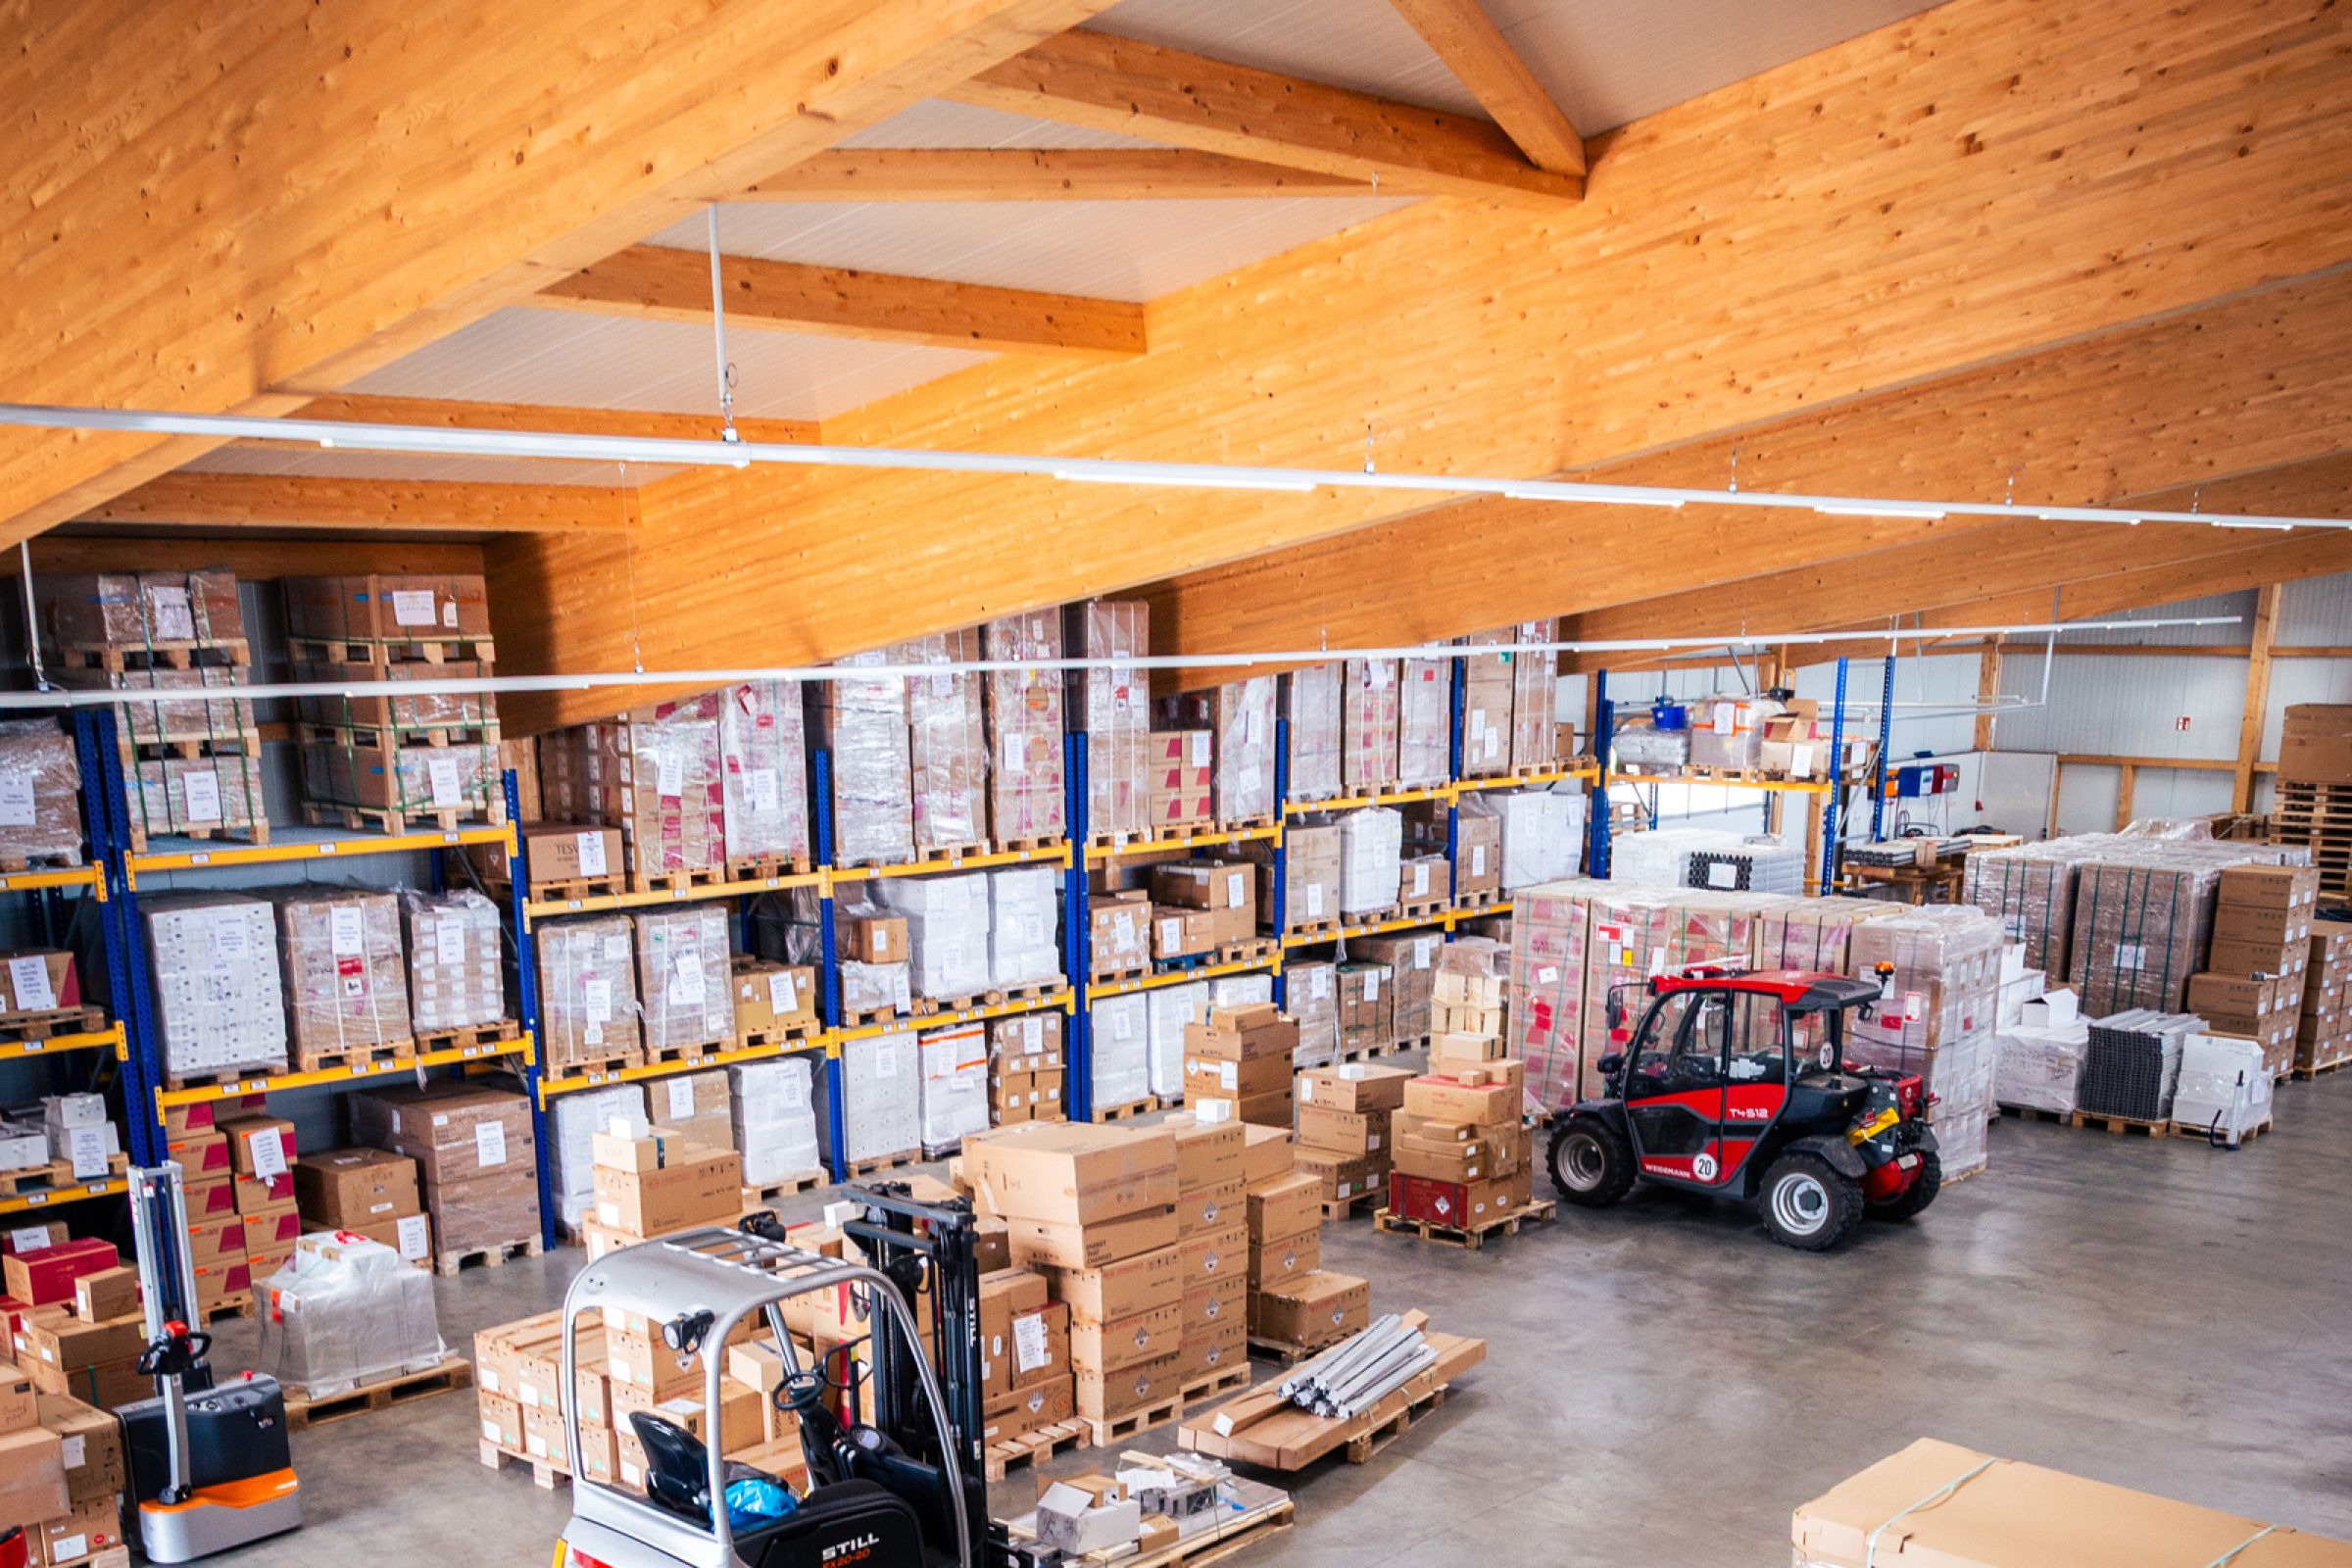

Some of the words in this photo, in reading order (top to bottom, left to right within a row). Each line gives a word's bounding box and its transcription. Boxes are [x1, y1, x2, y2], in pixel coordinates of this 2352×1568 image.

[1729, 1107, 1768, 1119] T4512
[1644, 1163, 1690, 1179] WEIDEMANN
[1698, 1158, 1712, 1176] 20
[968, 1298, 977, 1348] STILL
[822, 1532, 880, 1561] STILL
